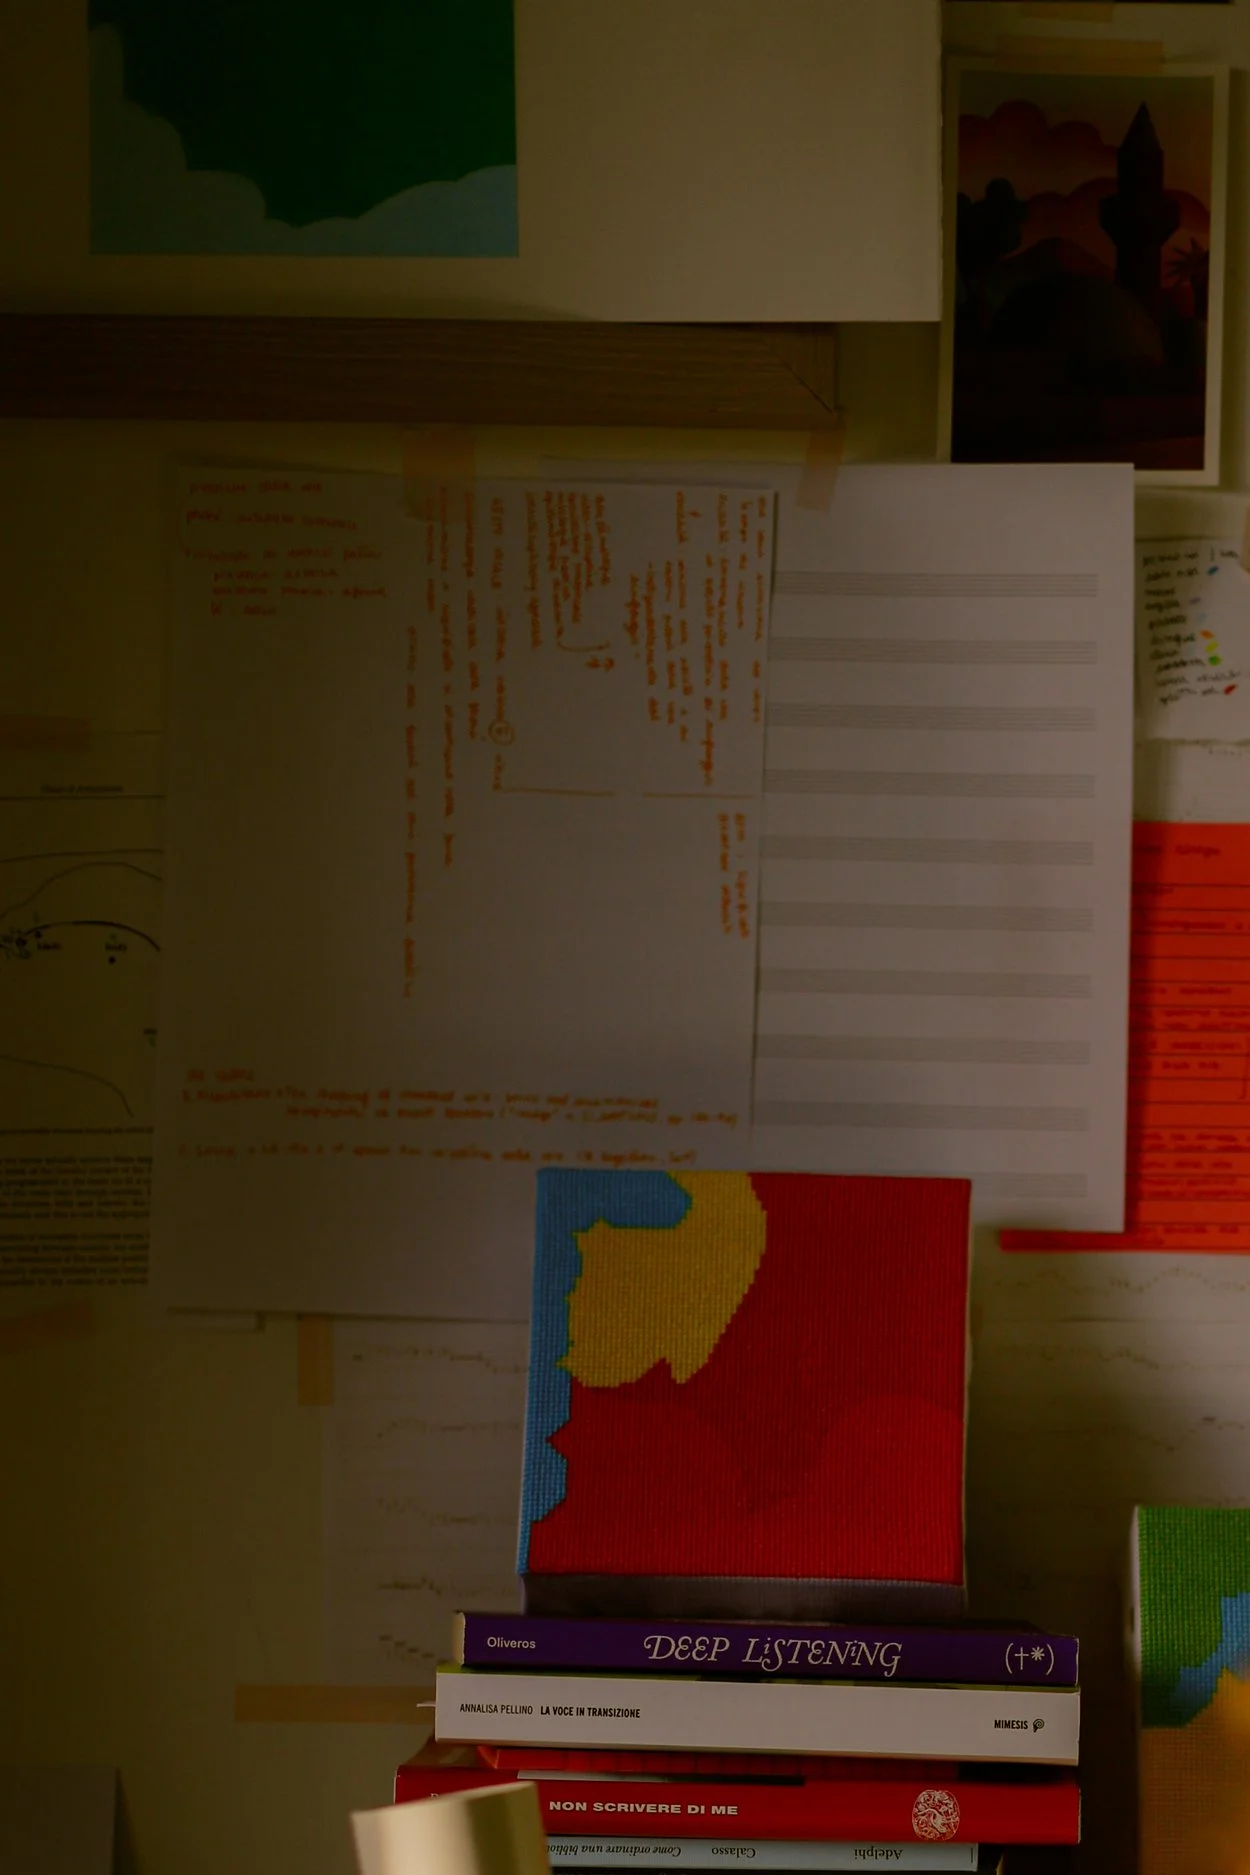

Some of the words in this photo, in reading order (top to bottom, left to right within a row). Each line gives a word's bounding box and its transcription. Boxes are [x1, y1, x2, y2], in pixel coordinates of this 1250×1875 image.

[486, 1636, 536, 1649] Oliveros
[642, 1635, 730, 1661] DEEP
[460, 1703, 498, 1714] ANNALISA
[500, 1705, 533, 1715] PELLINO
[540, 1705, 550, 1715] LA
[552, 1706, 573, 1716] VOCE
[575, 1707, 585, 1717] IN
[587, 1707, 641, 1719] TRANSIZIONE
[994, 1719, 1028, 1730] MIMESIS
[550, 1801, 587, 1812] NON
[593, 1803, 682, 1814] SCRIVERE
[688, 1804, 706, 1815] DI
[712, 1805, 738, 1815] ME
[582, 1845, 602, 1853] una
[606, 1846, 651, 1857] ordinare
[653, 1846, 682, 1857] Come
[711, 1847, 756, 1859] Calasso
[854, 1846, 903, 1862] Adelphi
